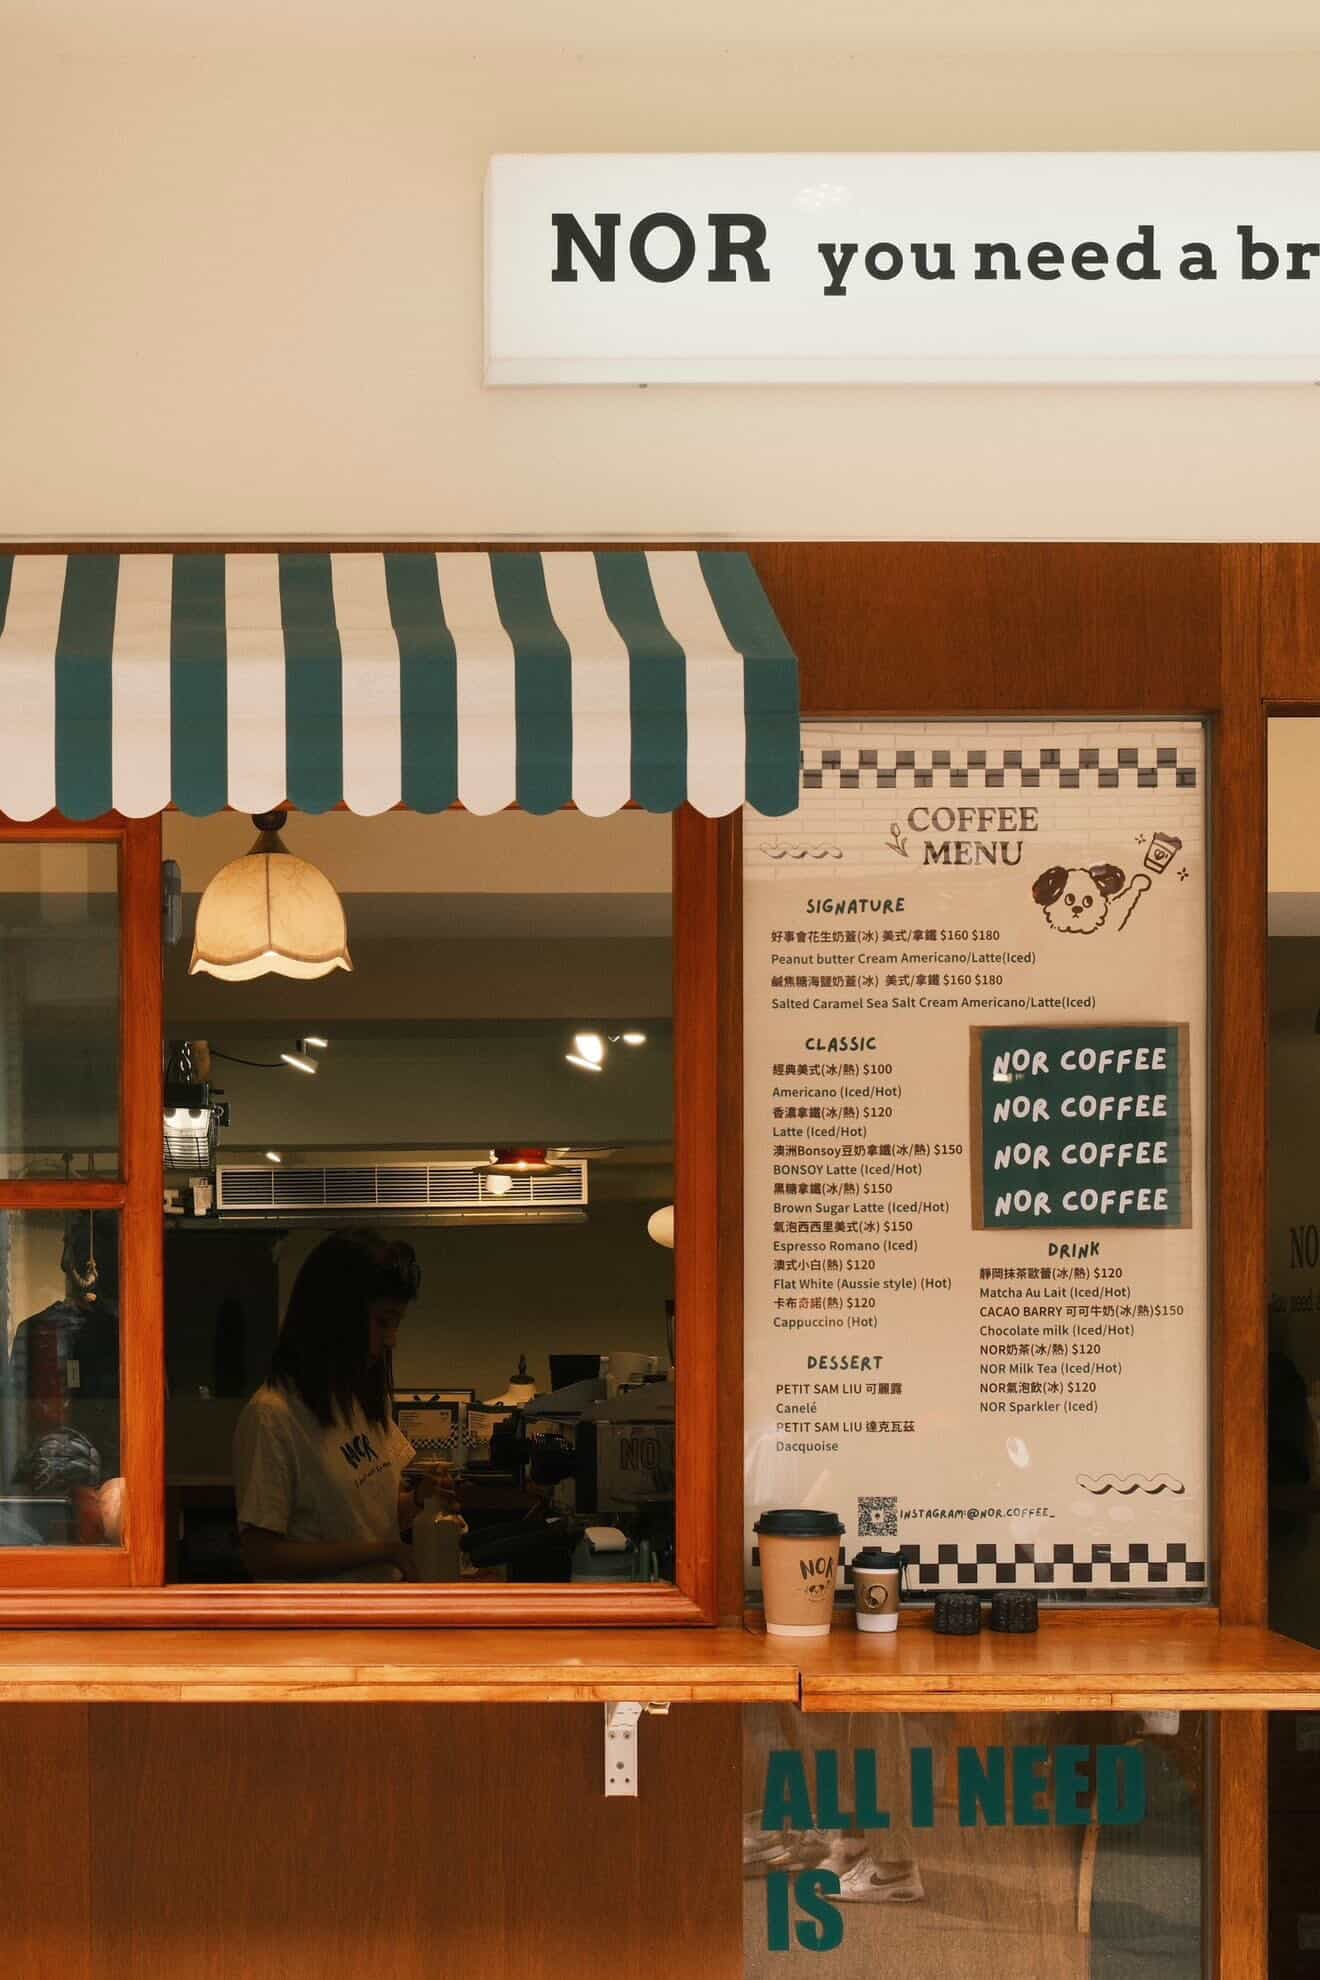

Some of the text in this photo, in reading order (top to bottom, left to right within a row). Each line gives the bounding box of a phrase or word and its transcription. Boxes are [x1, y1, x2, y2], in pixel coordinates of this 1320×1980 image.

[551, 212, 1320, 296] NOR you need a br
[907, 807, 1039, 832] COFFEE
[923, 840, 1023, 865] MENU
[806, 897, 904, 916] SIGNATURE
[940, 929, 969, 942] $160
[971, 929, 1000, 941] $180
[771, 952, 1036, 967] Peanut butter Cream Americano/Latte(Iced)
[943, 973, 972, 986] $160
[975, 973, 1003, 986] $180
[772, 996, 1095, 1009] Salted Caramel Sea Salt Cream Americano/Latte(Iced)
[805, 1036, 876, 1053] CLASSIC
[993, 1048, 1167, 1076] NOR COFFEE
[863, 1064, 892, 1076] $100
[772, 1085, 901, 1100] Americano (Iced/Hot)
[863, 1106, 892, 1119] $120
[993, 1095, 1167, 1123] NOR COFFEE
[773, 1125, 867, 1139] Latte (Iced/Hot)
[934, 1144, 963, 1156] $150
[994, 1142, 1168, 1170] NOR COFFEE
[773, 1163, 922, 1177] BONSOY Latte (Iced/Hot)
[864, 1182, 893, 1195] $150
[774, 1200, 949, 1216] Brown Sugar Latte (Iced/Hot)
[995, 1189, 1168, 1217] NOR COFFEE
[883, 1220, 912, 1232] $150
[773, 1240, 918, 1254] Espresso Romano (Iced)
[1049, 1241, 1100, 1259] DRINK
[846, 1259, 875, 1272] $120
[1094, 1267, 1123, 1280] $120
[774, 1278, 952, 1291] Flat White (Aussie style) (Hot)
[980, 1286, 1131, 1300] Matcha Au Lait (Iced/Hot)
[847, 1296, 875, 1310] $120
[980, 1306, 1020, 1317] CACAO
[1023, 1306, 1062, 1317] BARRY
[773, 1315, 877, 1330] Cappuccino (Hot)
[980, 1323, 1134, 1337] Chocolate milk (Iced/Hot)
[1072, 1343, 1101, 1356] $120
[808, 1355, 883, 1371] DESSERT
[980, 1362, 1122, 1375] NOR Milk Tea (Iced/Hot)
[776, 1384, 811, 1395] PETIT
[813, 1384, 839, 1395] SAM
[843, 1384, 862, 1394] LIU
[1067, 1381, 1096, 1394] $120
[776, 1401, 817, 1414] Canelé
[980, 1400, 1098, 1415] NOR Sparkler (Iced)
[777, 1422, 811, 1432] PETIT
[814, 1422, 839, 1432] SAM
[843, 1422, 862, 1432] LIU
[776, 1440, 838, 1454] Dacquoise
[761, 1744, 1148, 1831] ALL I NEED
[765, 1869, 844, 1952] IS
